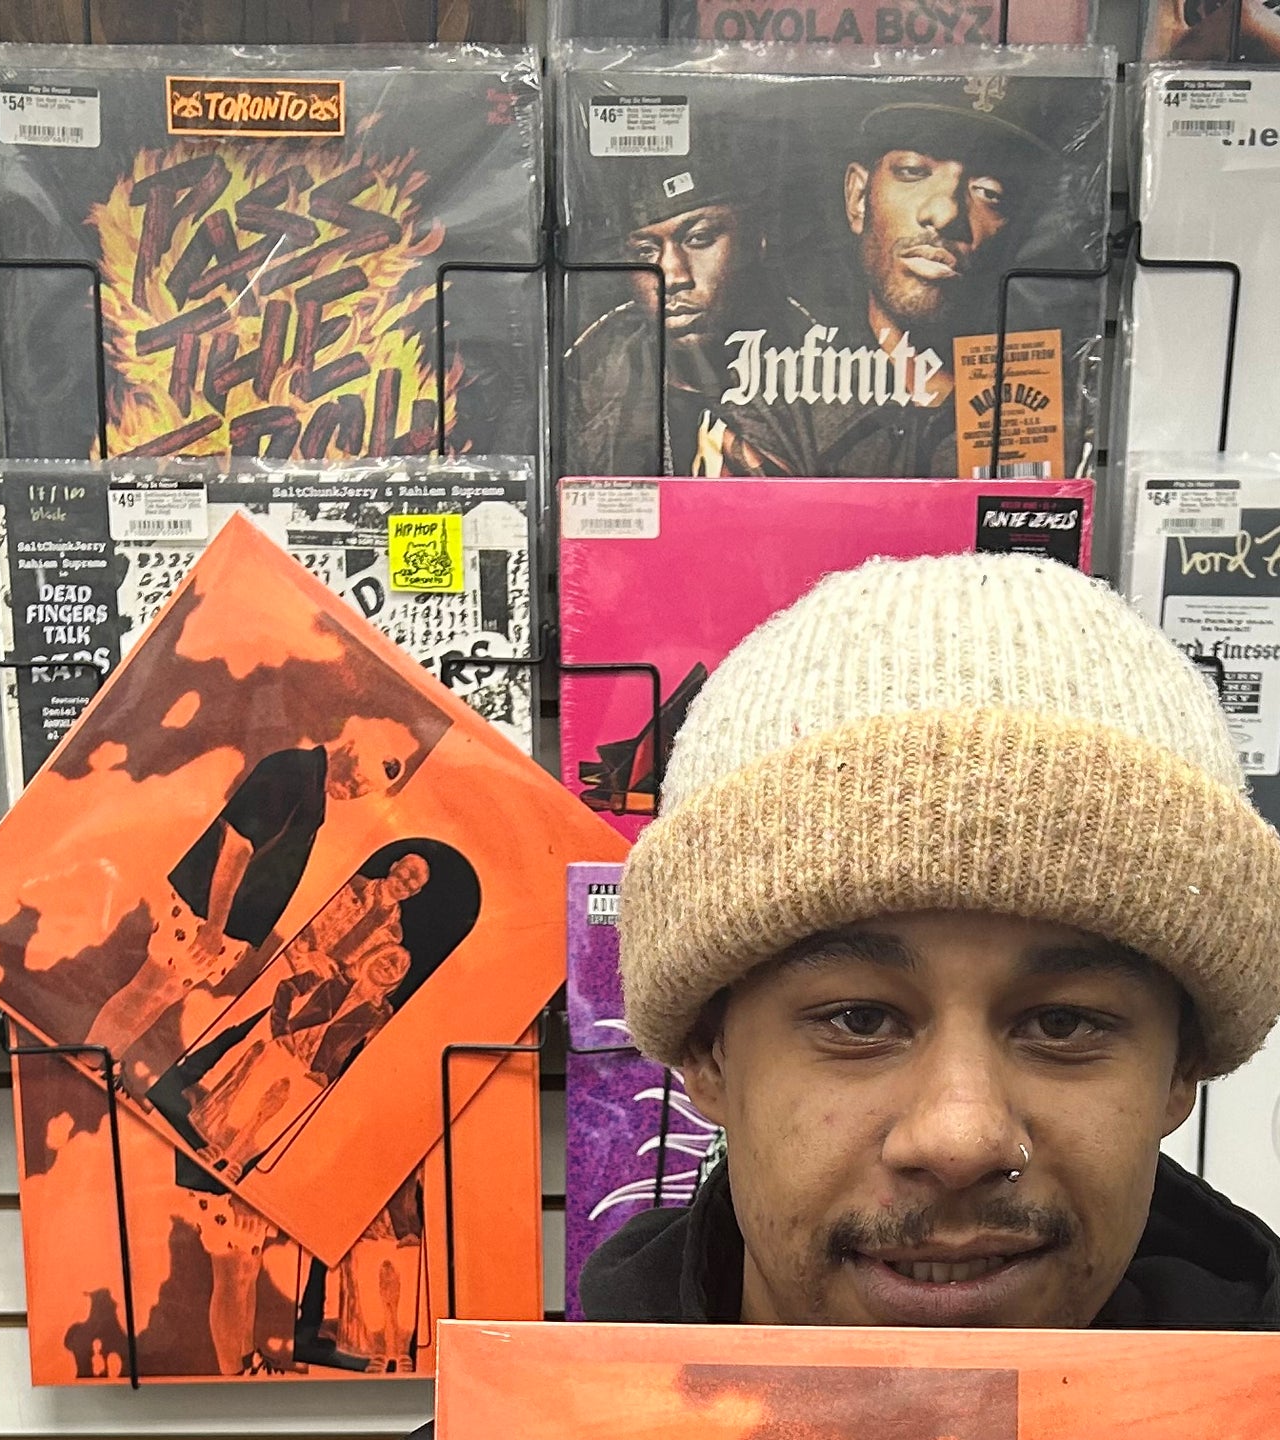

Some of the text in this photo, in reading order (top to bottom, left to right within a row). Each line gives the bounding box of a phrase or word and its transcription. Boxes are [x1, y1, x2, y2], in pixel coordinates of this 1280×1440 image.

[875, 6, 994, 44] BOYZ
[206, 90, 308, 122] TORONTO
[130, 155, 402, 317] PASS
[135, 264, 370, 419] THE
[721, 323, 946, 408] Infinite
[1015, 383, 1051, 412] DEEP
[112, 493, 134, 508] $49
[273, 486, 378, 499] SaltChunkJerry
[451, 487, 505, 498] Supreme
[17, 541, 107, 553] SaltChunkJerry
[62, 558, 108, 570] Supreme
[39, 584, 93, 604] DEAD
[26, 604, 109, 625] FINGERS
[42, 625, 91, 645] TALK
